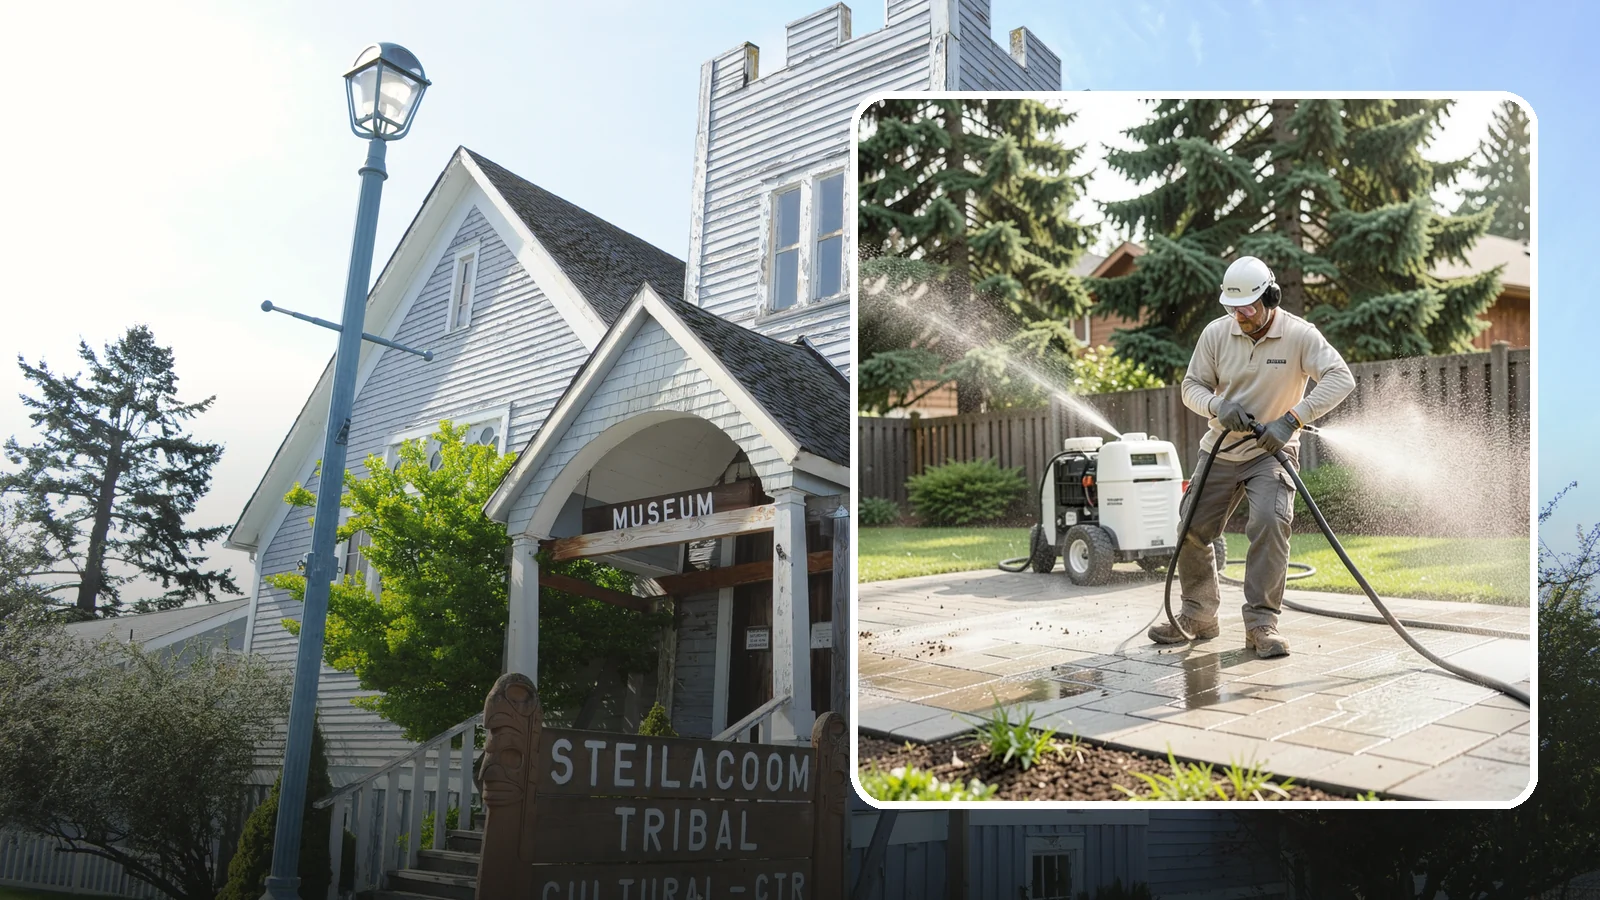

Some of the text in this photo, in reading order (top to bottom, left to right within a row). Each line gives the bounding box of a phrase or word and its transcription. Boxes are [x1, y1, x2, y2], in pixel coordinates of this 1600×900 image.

[612, 491, 714, 531] MUSEUM
[550, 738, 810, 793] STEILACOOM
[615, 806, 758, 852] TRIBAL
